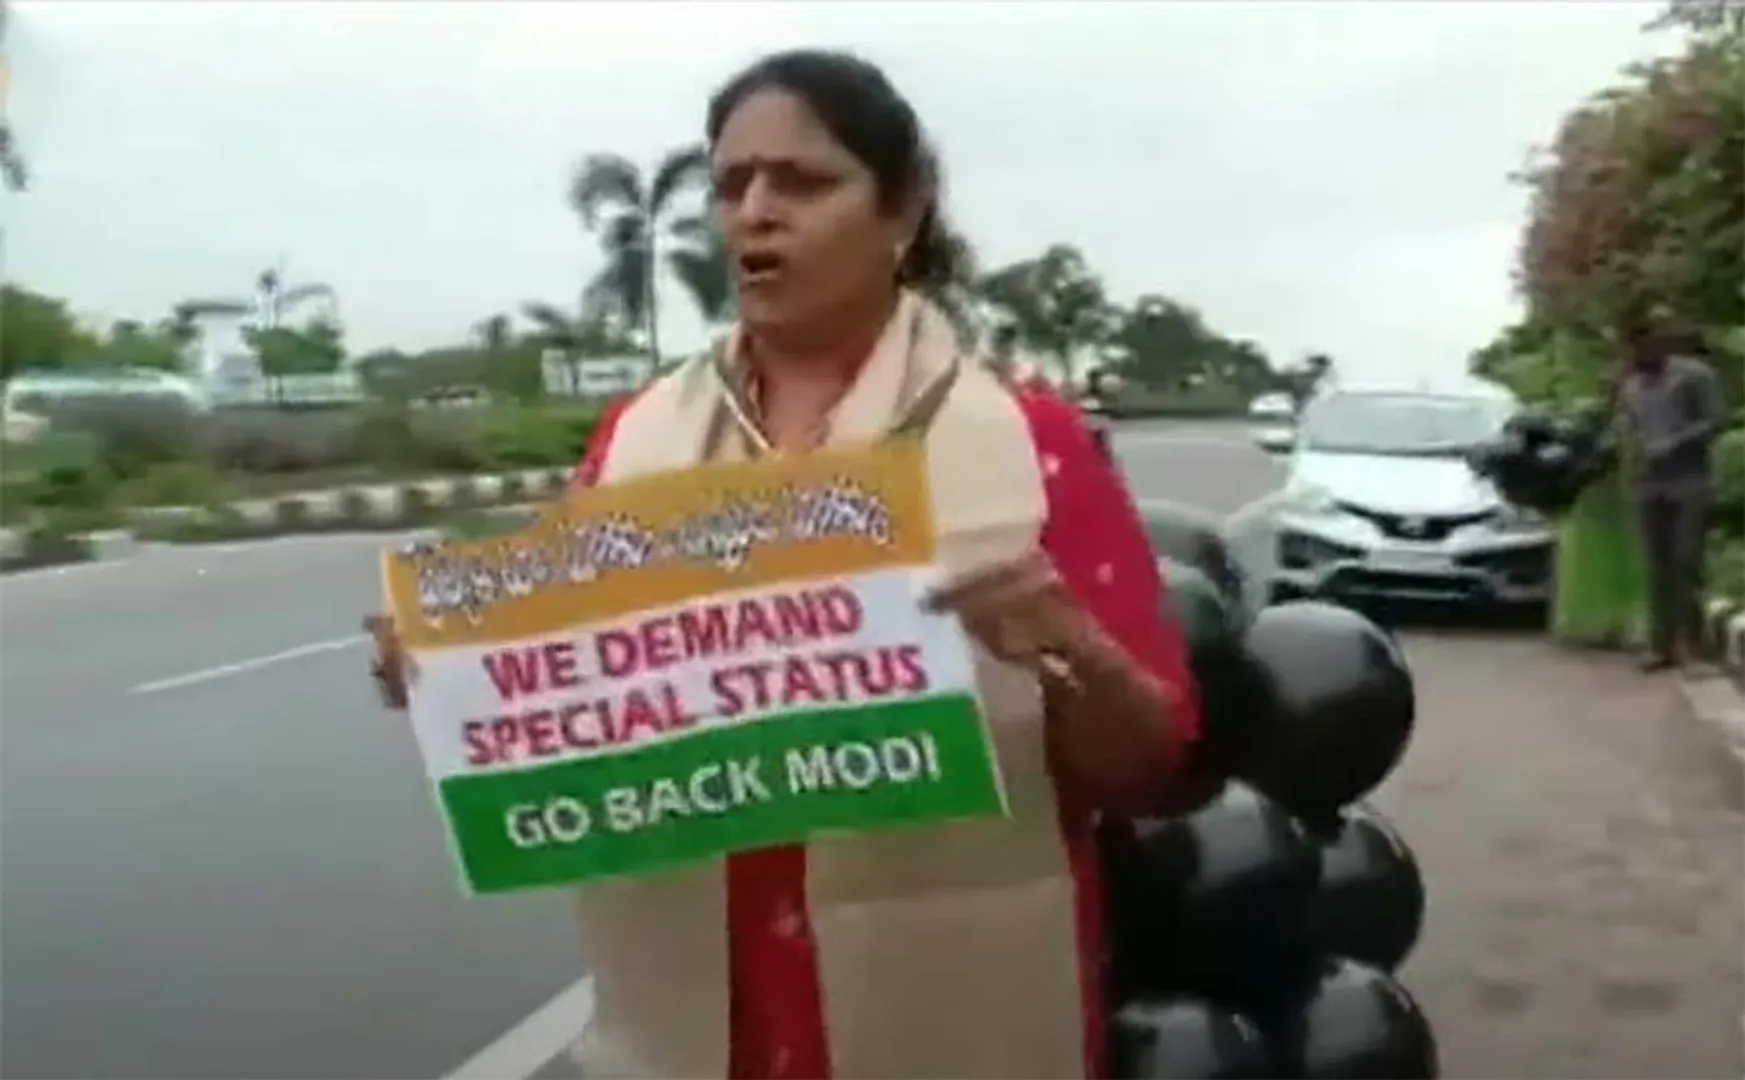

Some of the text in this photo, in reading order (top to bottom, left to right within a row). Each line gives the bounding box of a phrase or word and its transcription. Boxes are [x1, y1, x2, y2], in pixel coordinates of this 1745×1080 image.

[482, 587, 862, 699] WE DEMAND
[463, 646, 928, 765] SPECIAL STATUS
[505, 732, 941, 848] GO BACK MODI
